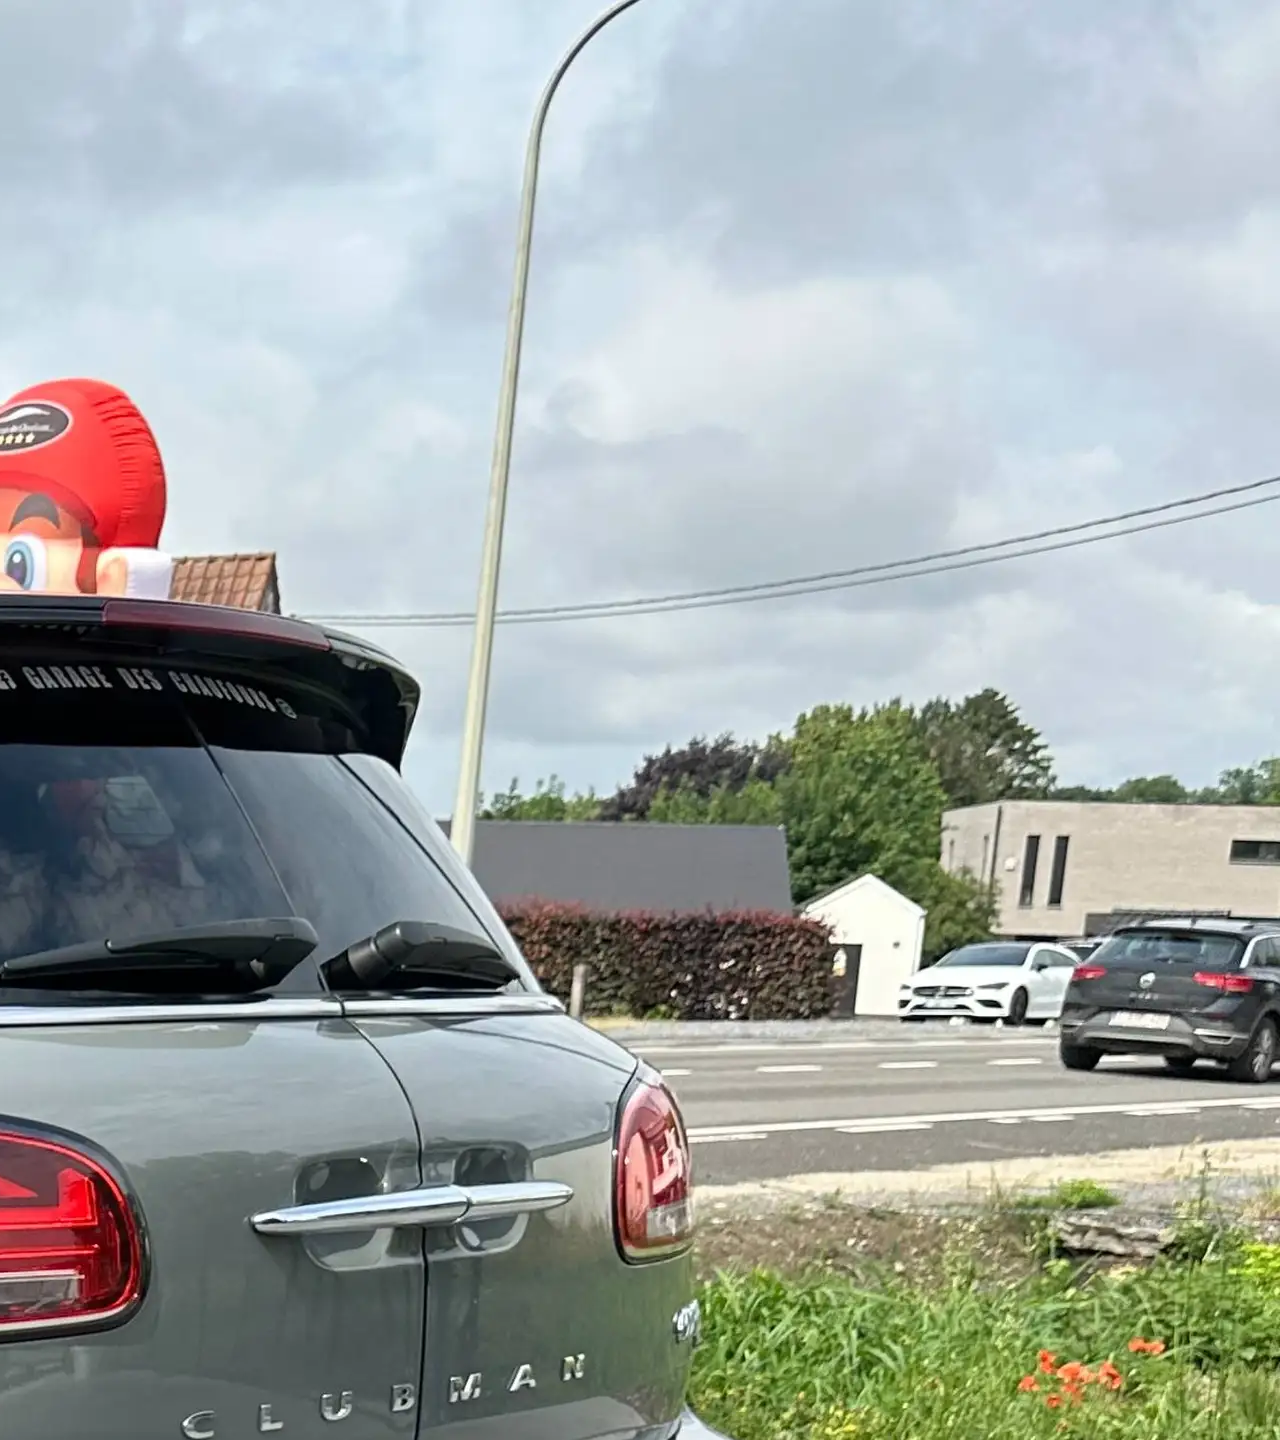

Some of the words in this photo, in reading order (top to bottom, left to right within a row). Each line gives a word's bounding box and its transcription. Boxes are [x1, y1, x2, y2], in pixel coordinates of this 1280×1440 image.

[21, 665, 113, 690] GARAGE
[117, 667, 163, 692] DES
[167, 671, 277, 713] CHAUFOURS
[181, 1353, 586, 1440] CLUBMAN
